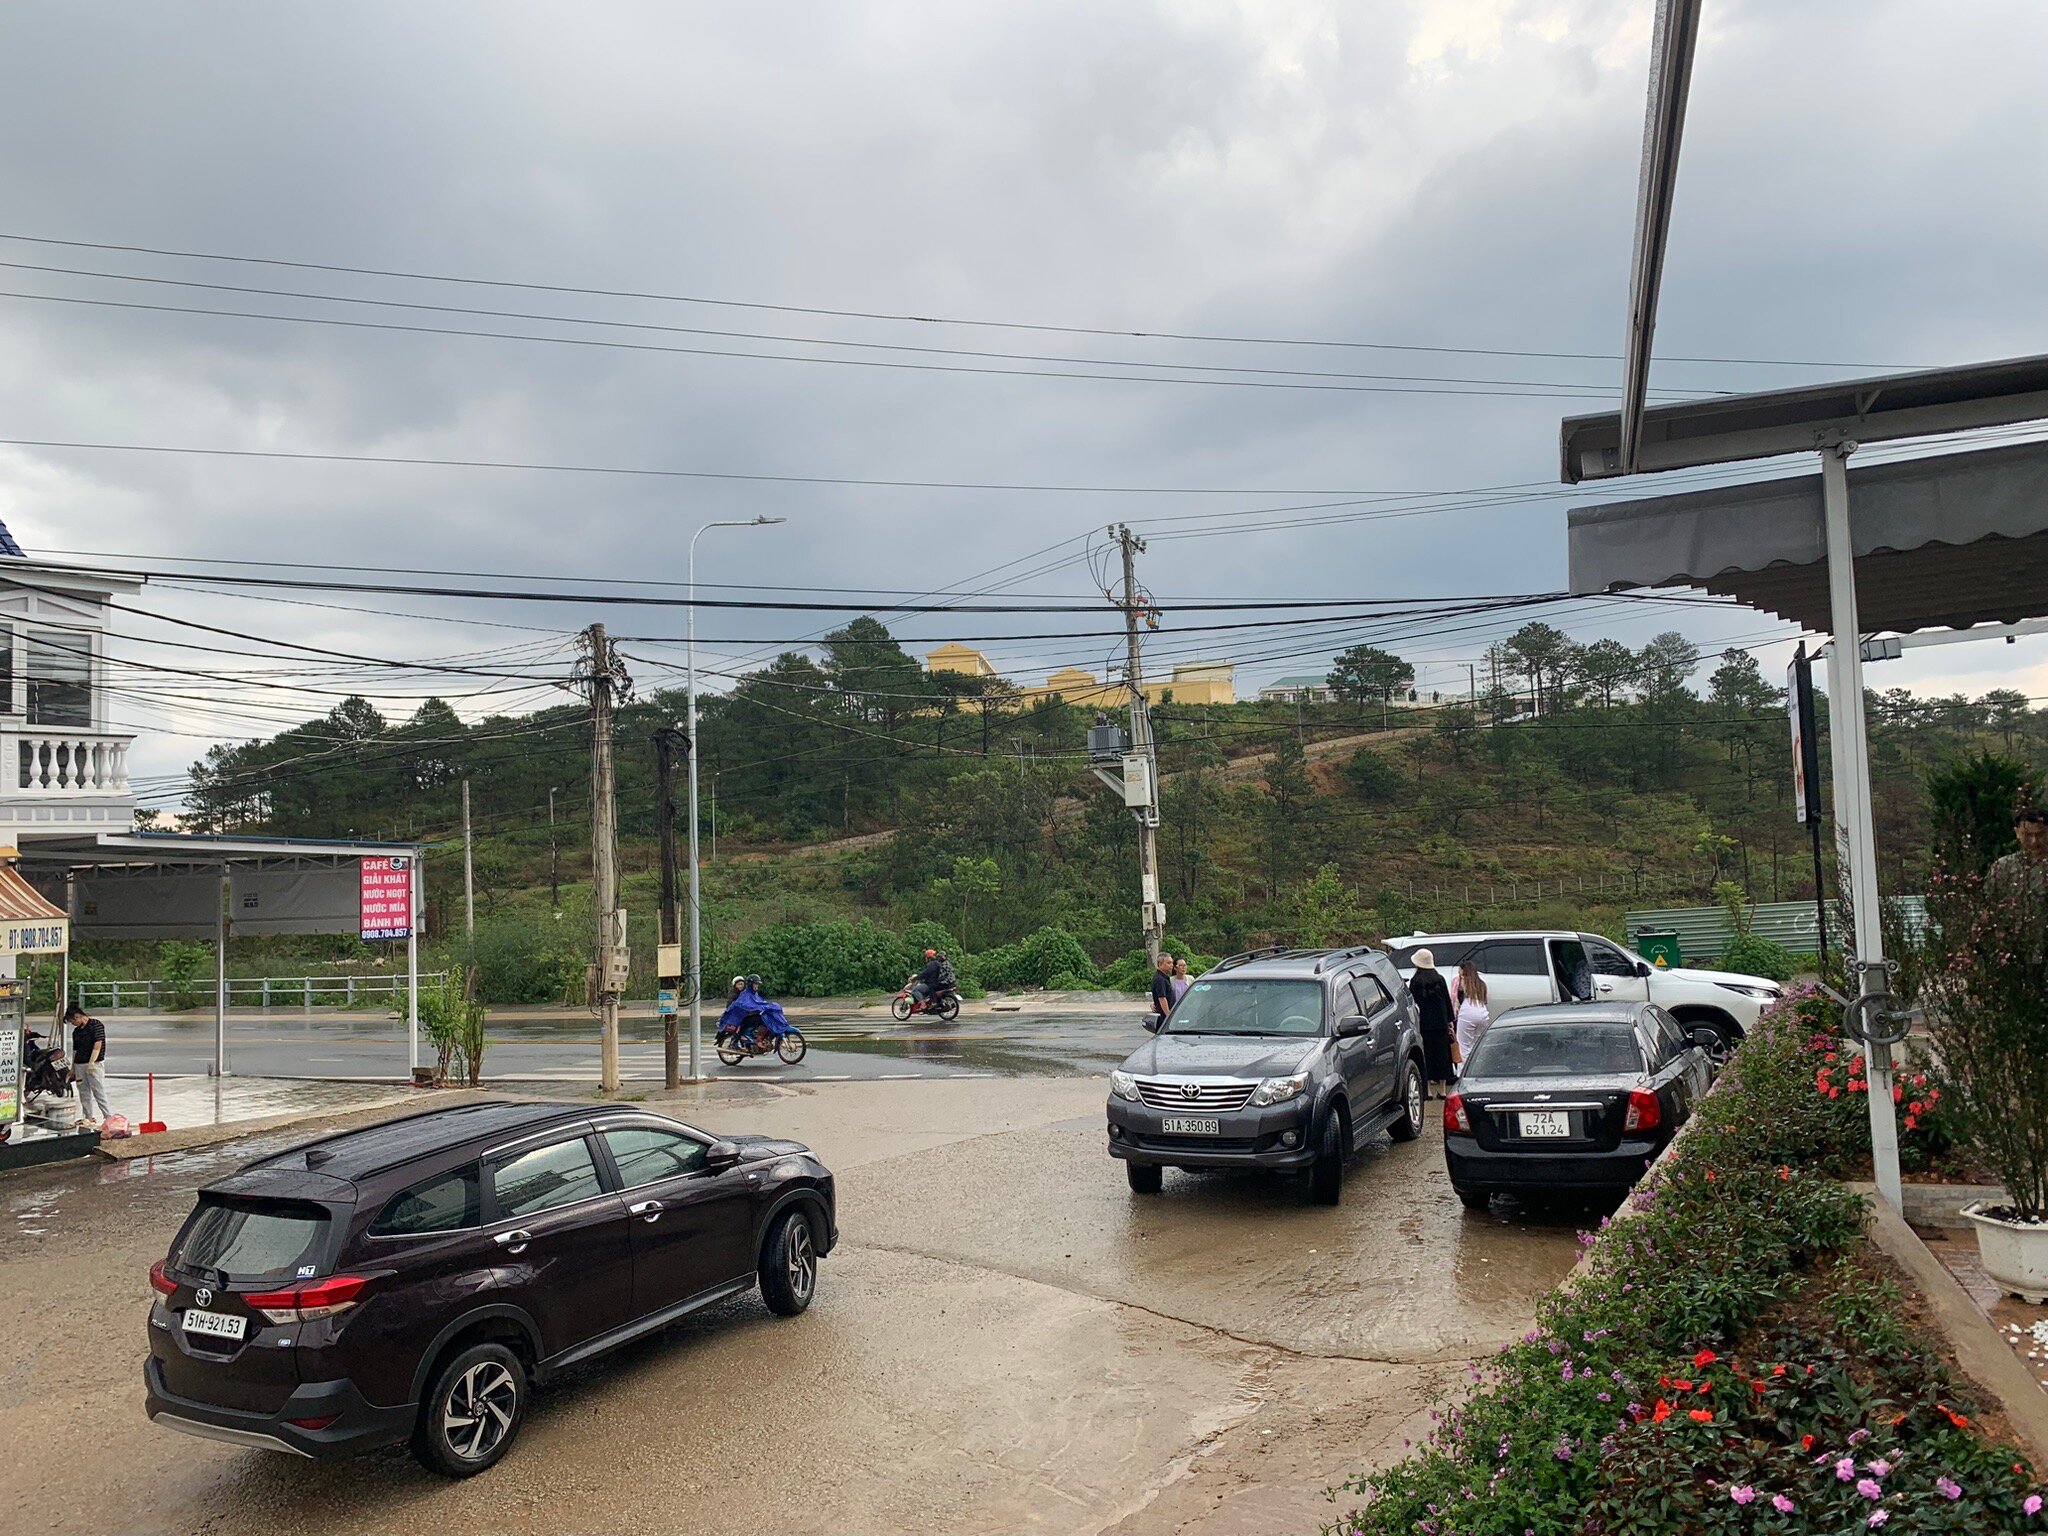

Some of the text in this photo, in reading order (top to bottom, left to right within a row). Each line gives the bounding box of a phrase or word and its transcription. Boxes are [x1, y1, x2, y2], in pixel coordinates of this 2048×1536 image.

[363, 859, 389, 870] CAFÉ
[363, 873, 407, 885] GIẢI KHÁT
[363, 888, 407, 900] NƯỚC NGỌT
[363, 901, 406, 913] NƯỚC MÍA
[363, 915, 407, 928] BÁNH MÌ
[361, 928, 408, 939] 0908.704.857
[1532, 1113, 1554, 1124] 72A
[1525, 1124, 1564, 1135] 621.24
